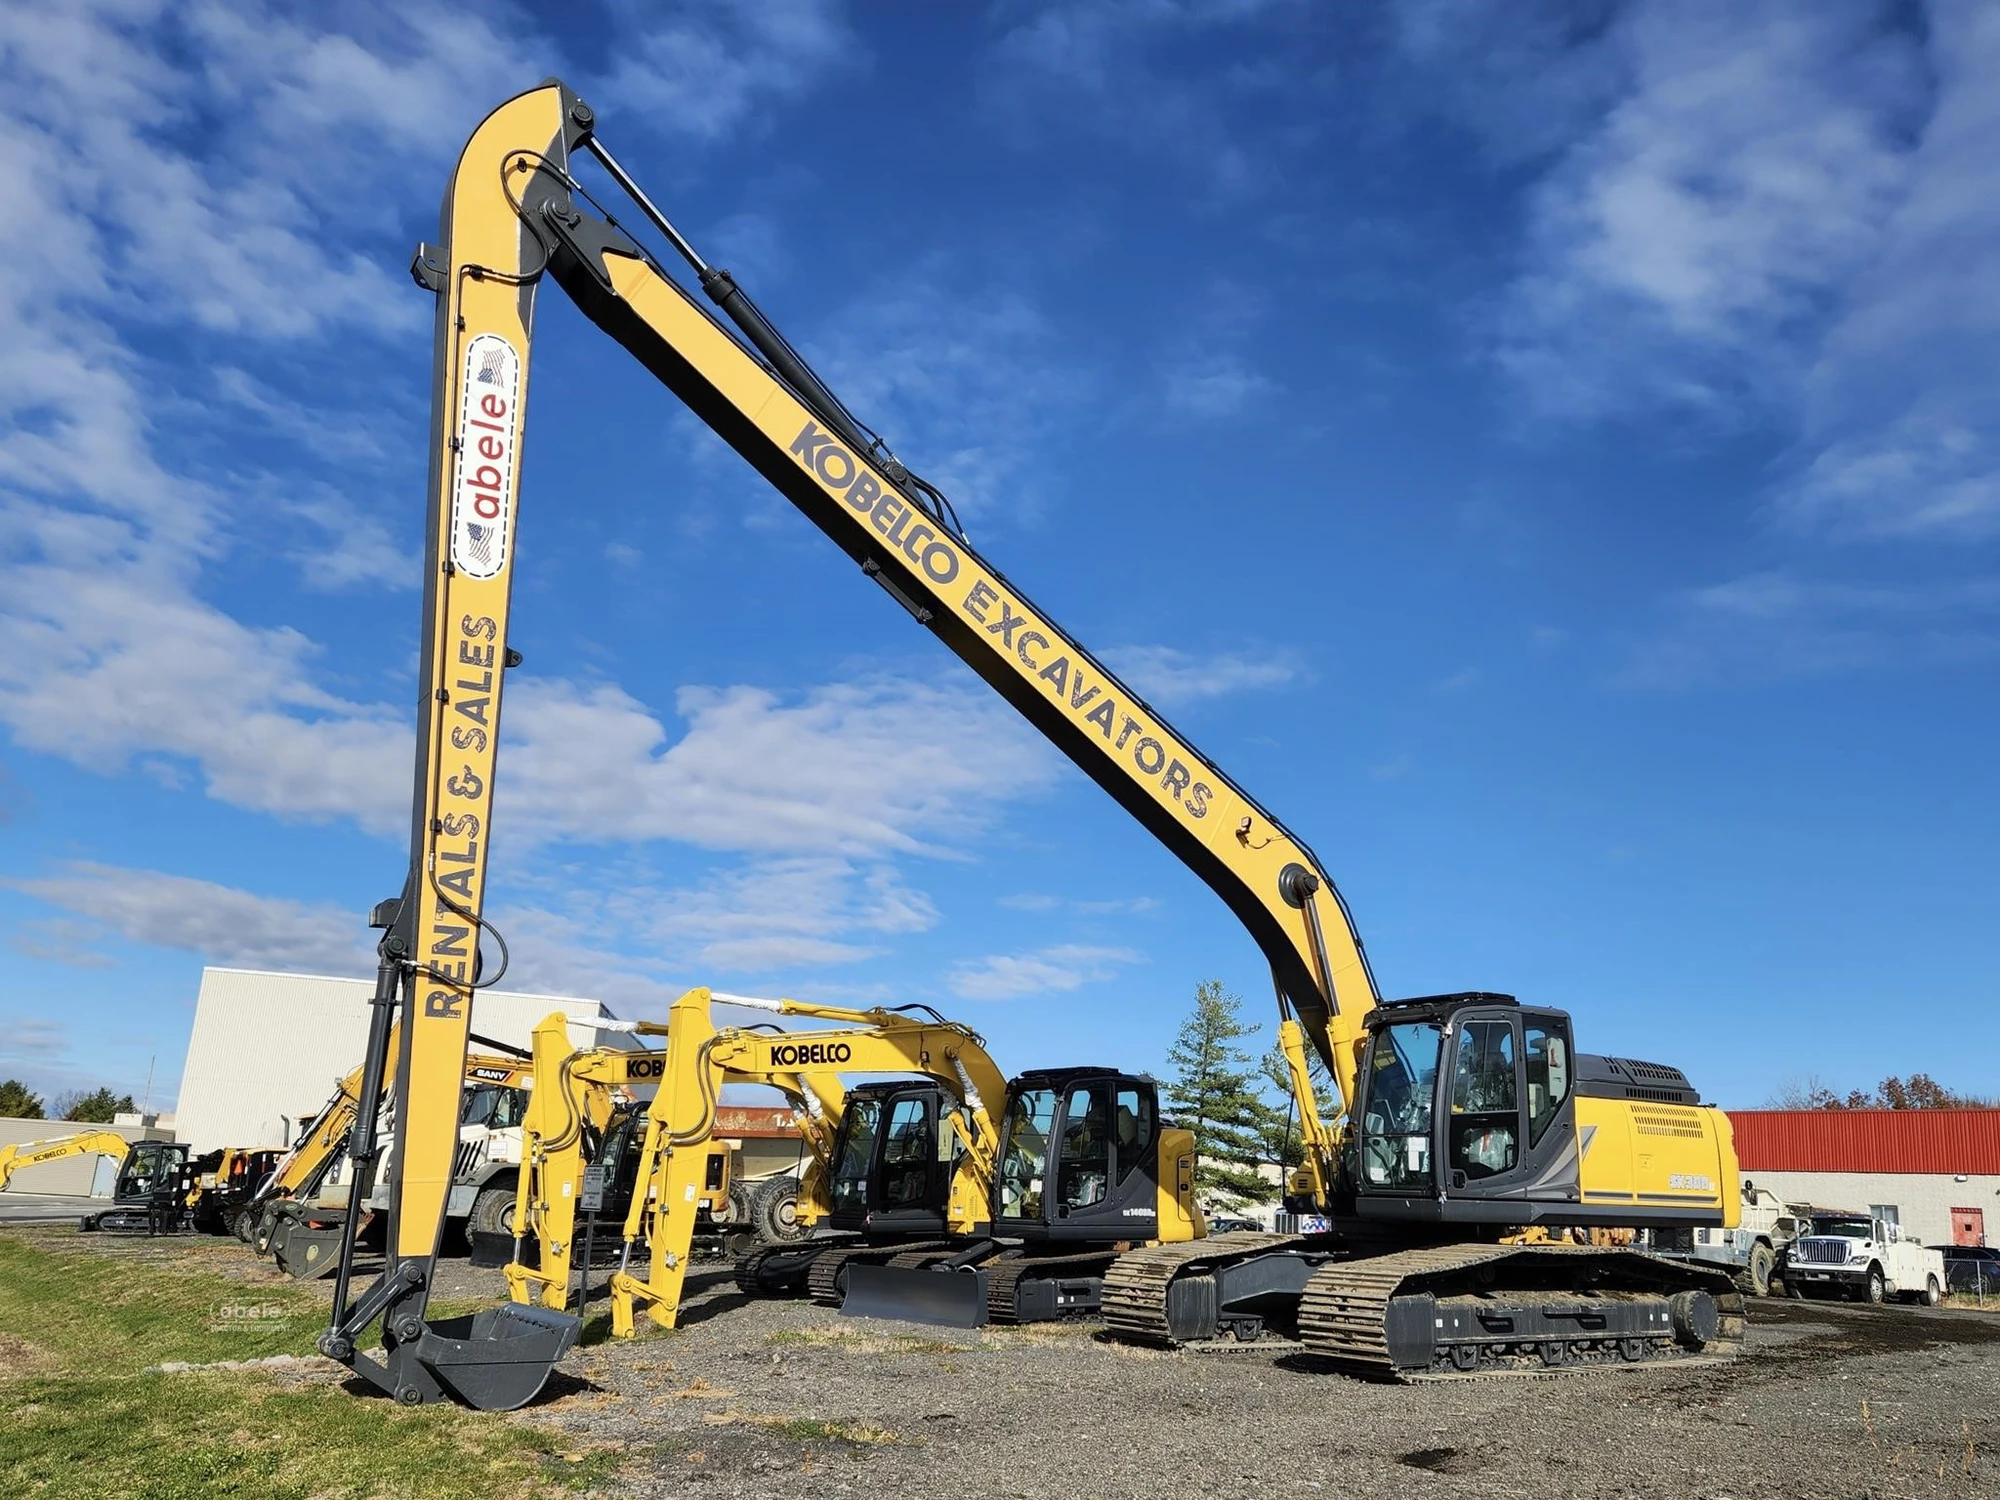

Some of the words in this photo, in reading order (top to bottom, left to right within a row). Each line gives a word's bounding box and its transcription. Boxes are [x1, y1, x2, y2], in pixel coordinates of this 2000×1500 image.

[466, 394, 507, 519] abele
[788, 420, 959, 584] KOBELCO
[962, 579, 1213, 819] EXCAVATORS
[452, 614, 497, 753] SALES
[447, 764, 484, 800] &
[424, 812, 481, 1019] RENTALS
[626, 1059, 666, 1078] KOB
[771, 1043, 851, 1066] KOBELCO
[476, 1069, 506, 1080] SANY
[33, 1148, 67, 1162] KOBELCO
